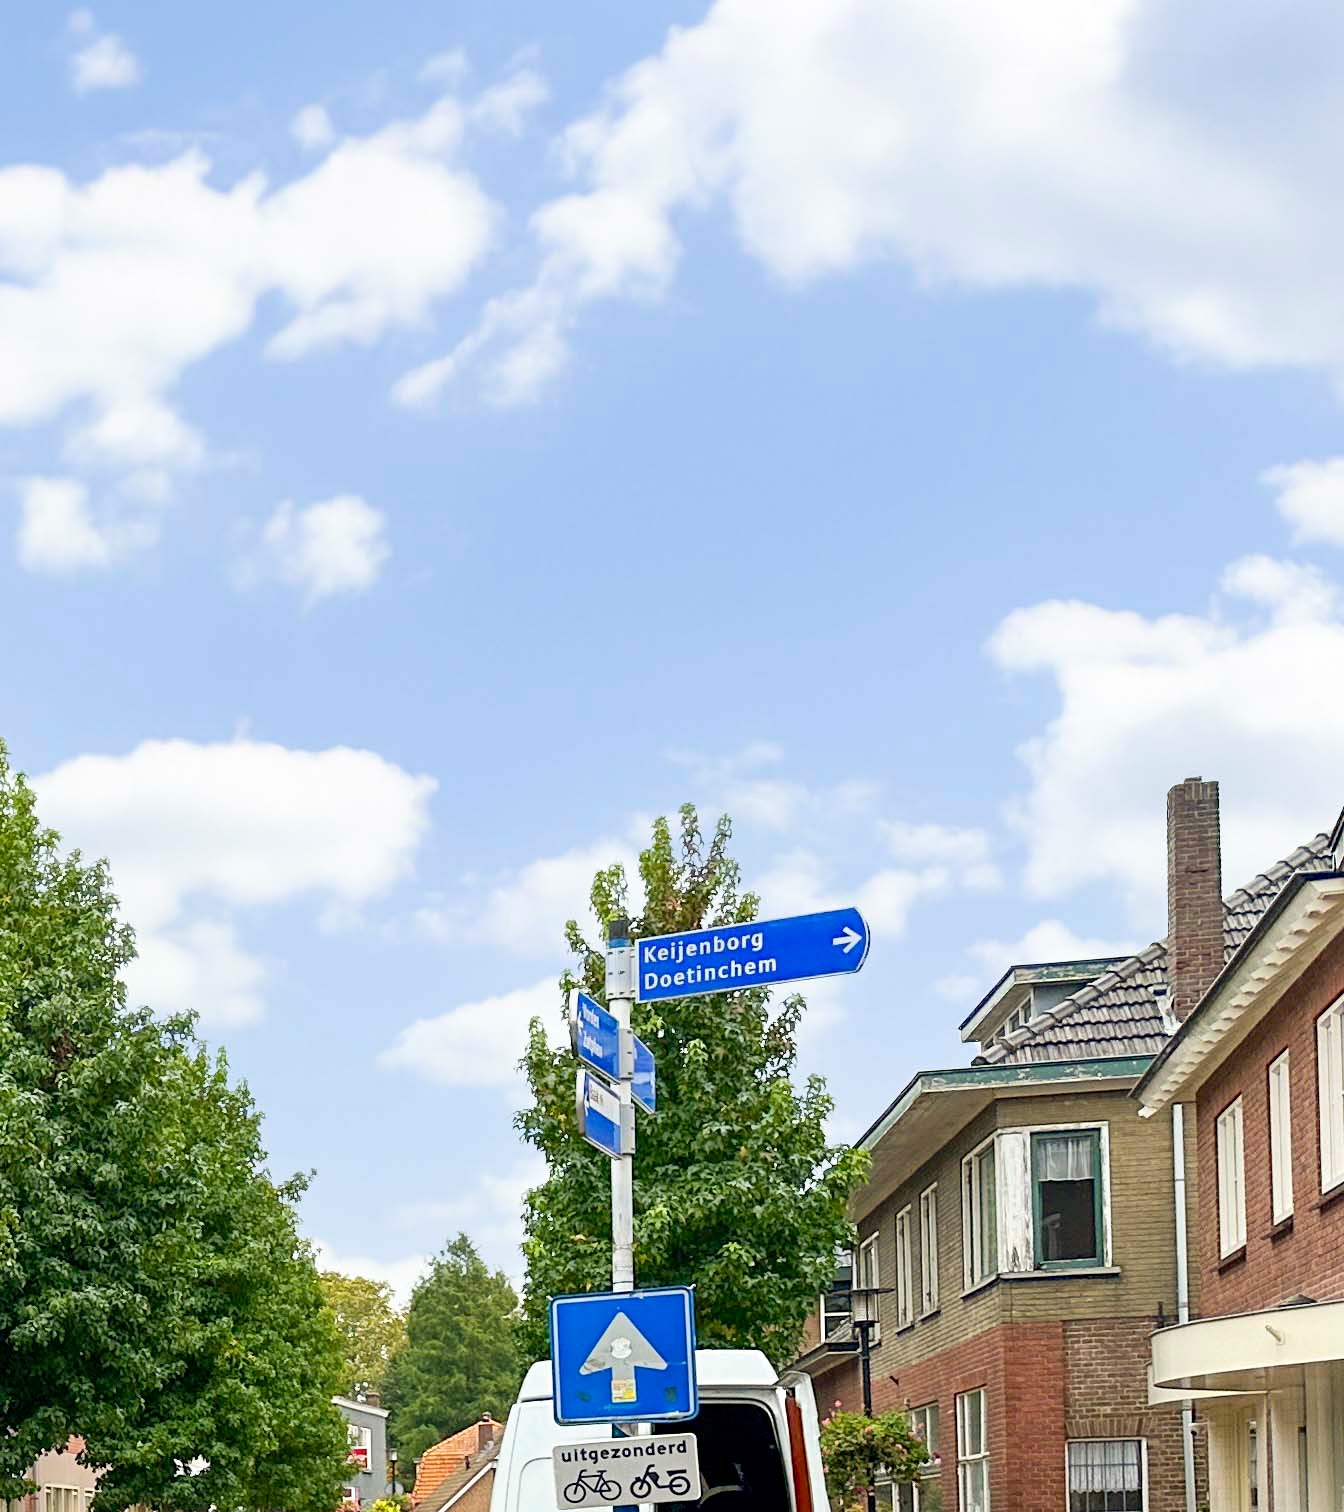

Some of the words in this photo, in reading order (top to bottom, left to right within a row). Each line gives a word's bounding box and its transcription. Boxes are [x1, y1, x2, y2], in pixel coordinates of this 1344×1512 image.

[643, 932, 764, 964] Keijenborg
[644, 957, 777, 991] Doetinchem
[561, 1440, 687, 1464] uitgezonderd
